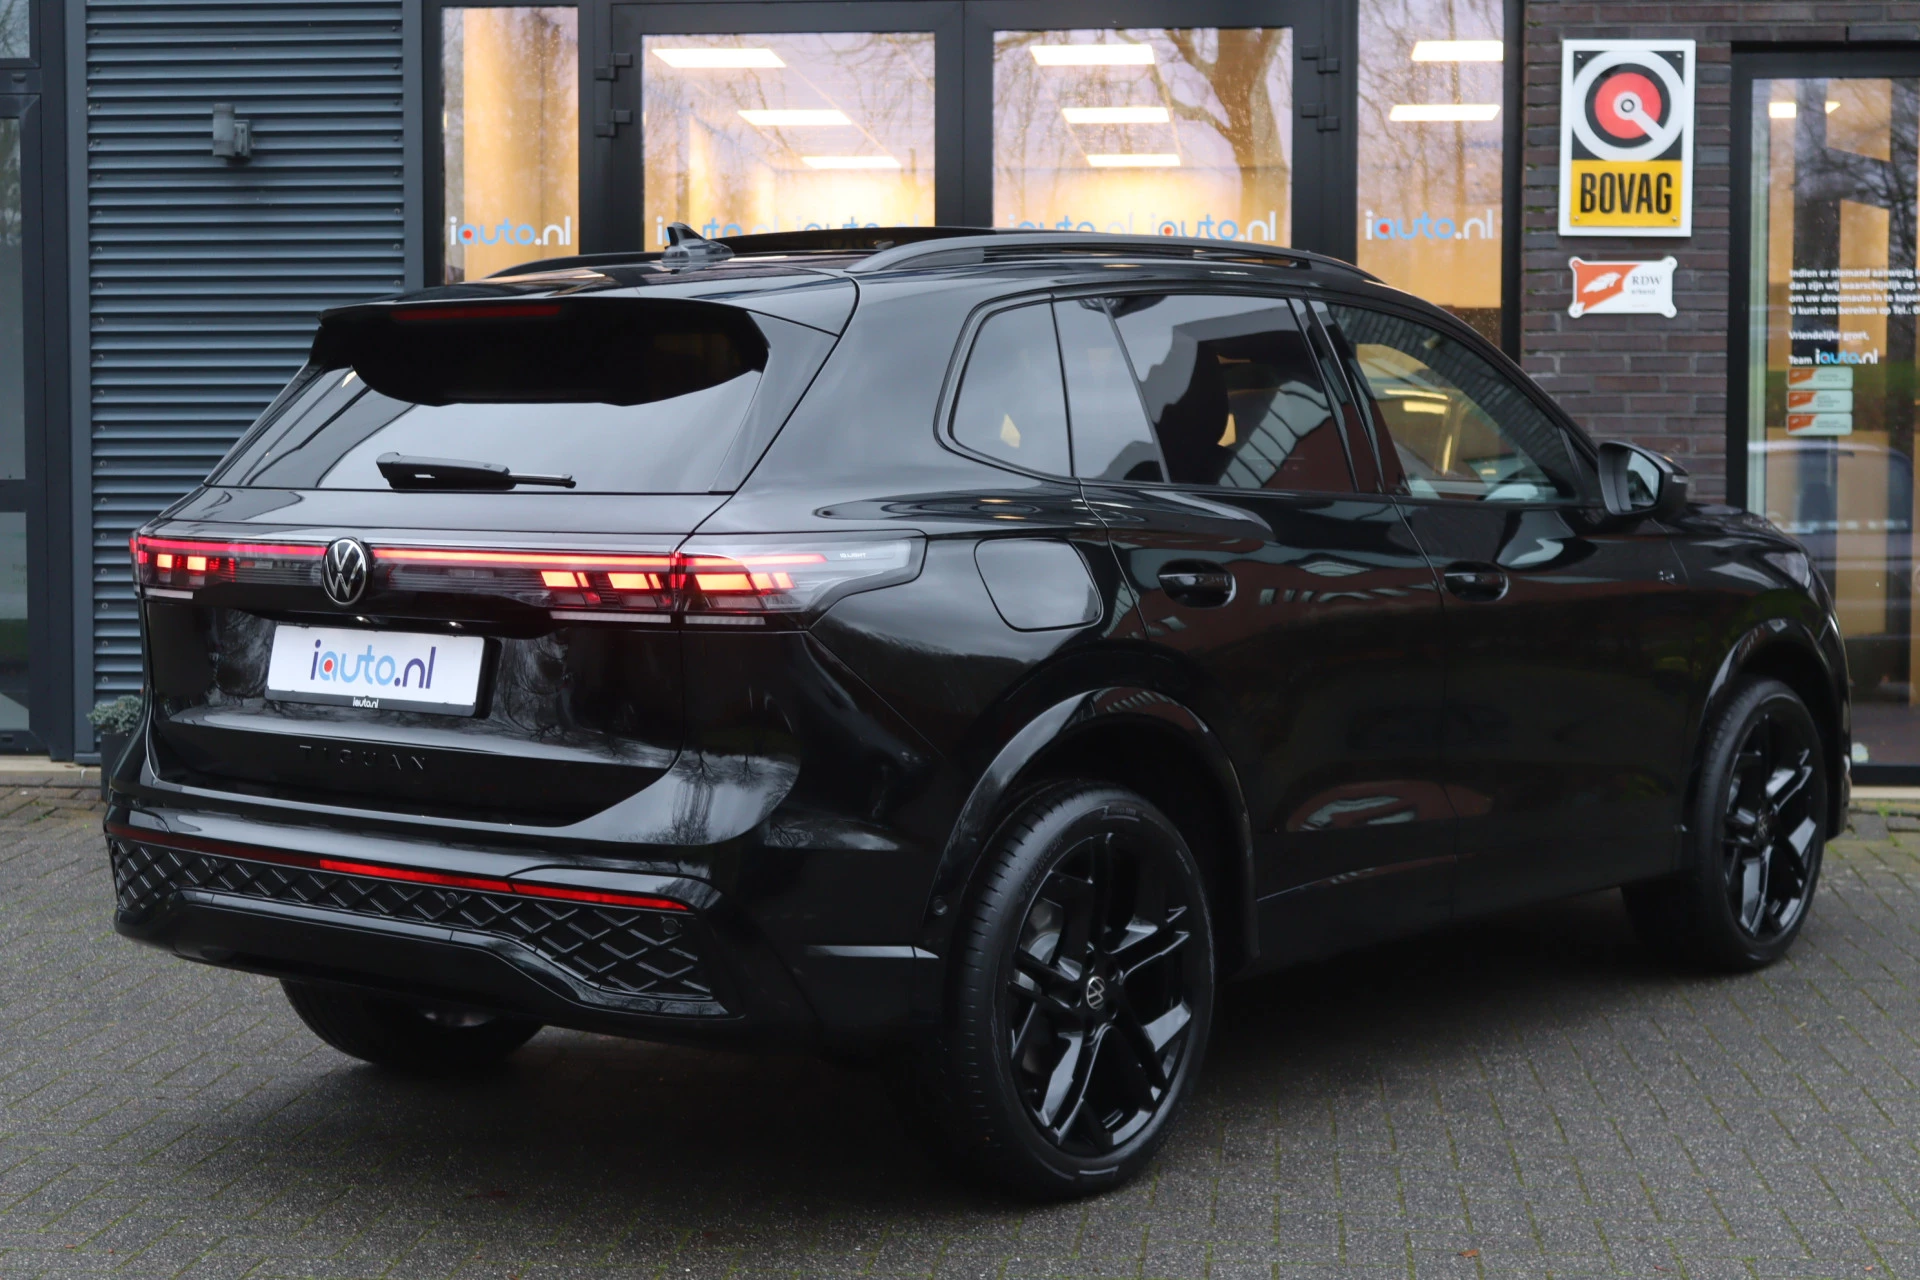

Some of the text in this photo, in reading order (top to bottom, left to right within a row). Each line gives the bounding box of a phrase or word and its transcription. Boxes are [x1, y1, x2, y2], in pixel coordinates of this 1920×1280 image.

[1580, 172, 1672, 214] BOVAG
[1365, 209, 1493, 240] iauto.nl
[450, 216, 571, 245] iauto.nl
[1789, 268, 1818, 278] Indien
[1819, 270, 1829, 278] er
[1830, 268, 1870, 278] niemand
[1872, 268, 1914, 279] aanwezig
[1632, 275, 1663, 285] RDW
[1788, 281, 1807, 290] dan
[1808, 281, 1824, 292] zijn
[1825, 281, 1839, 292] wij
[1841, 281, 1902, 292] waarschijnlijk
[1903, 282, 1916, 291] op
[1788, 295, 1804, 303] om
[1805, 295, 1820, 303] uw
[1821, 294, 1872, 303] droomauto
[1873, 294, 1883, 302] in
[1884, 294, 1894, 303] te
[1788, 306, 1797, 315] U
[1797, 306, 1819, 315] kunt
[1820, 307, 1837, 315] ons
[1838, 306, 1878, 315] bereiken
[1878, 307, 1891, 316] op
[1788, 330, 1841, 341] Vriendelijke
[1788, 348, 1878, 364] Team iauto.nl
[310, 639, 437, 689] iauto.nl
